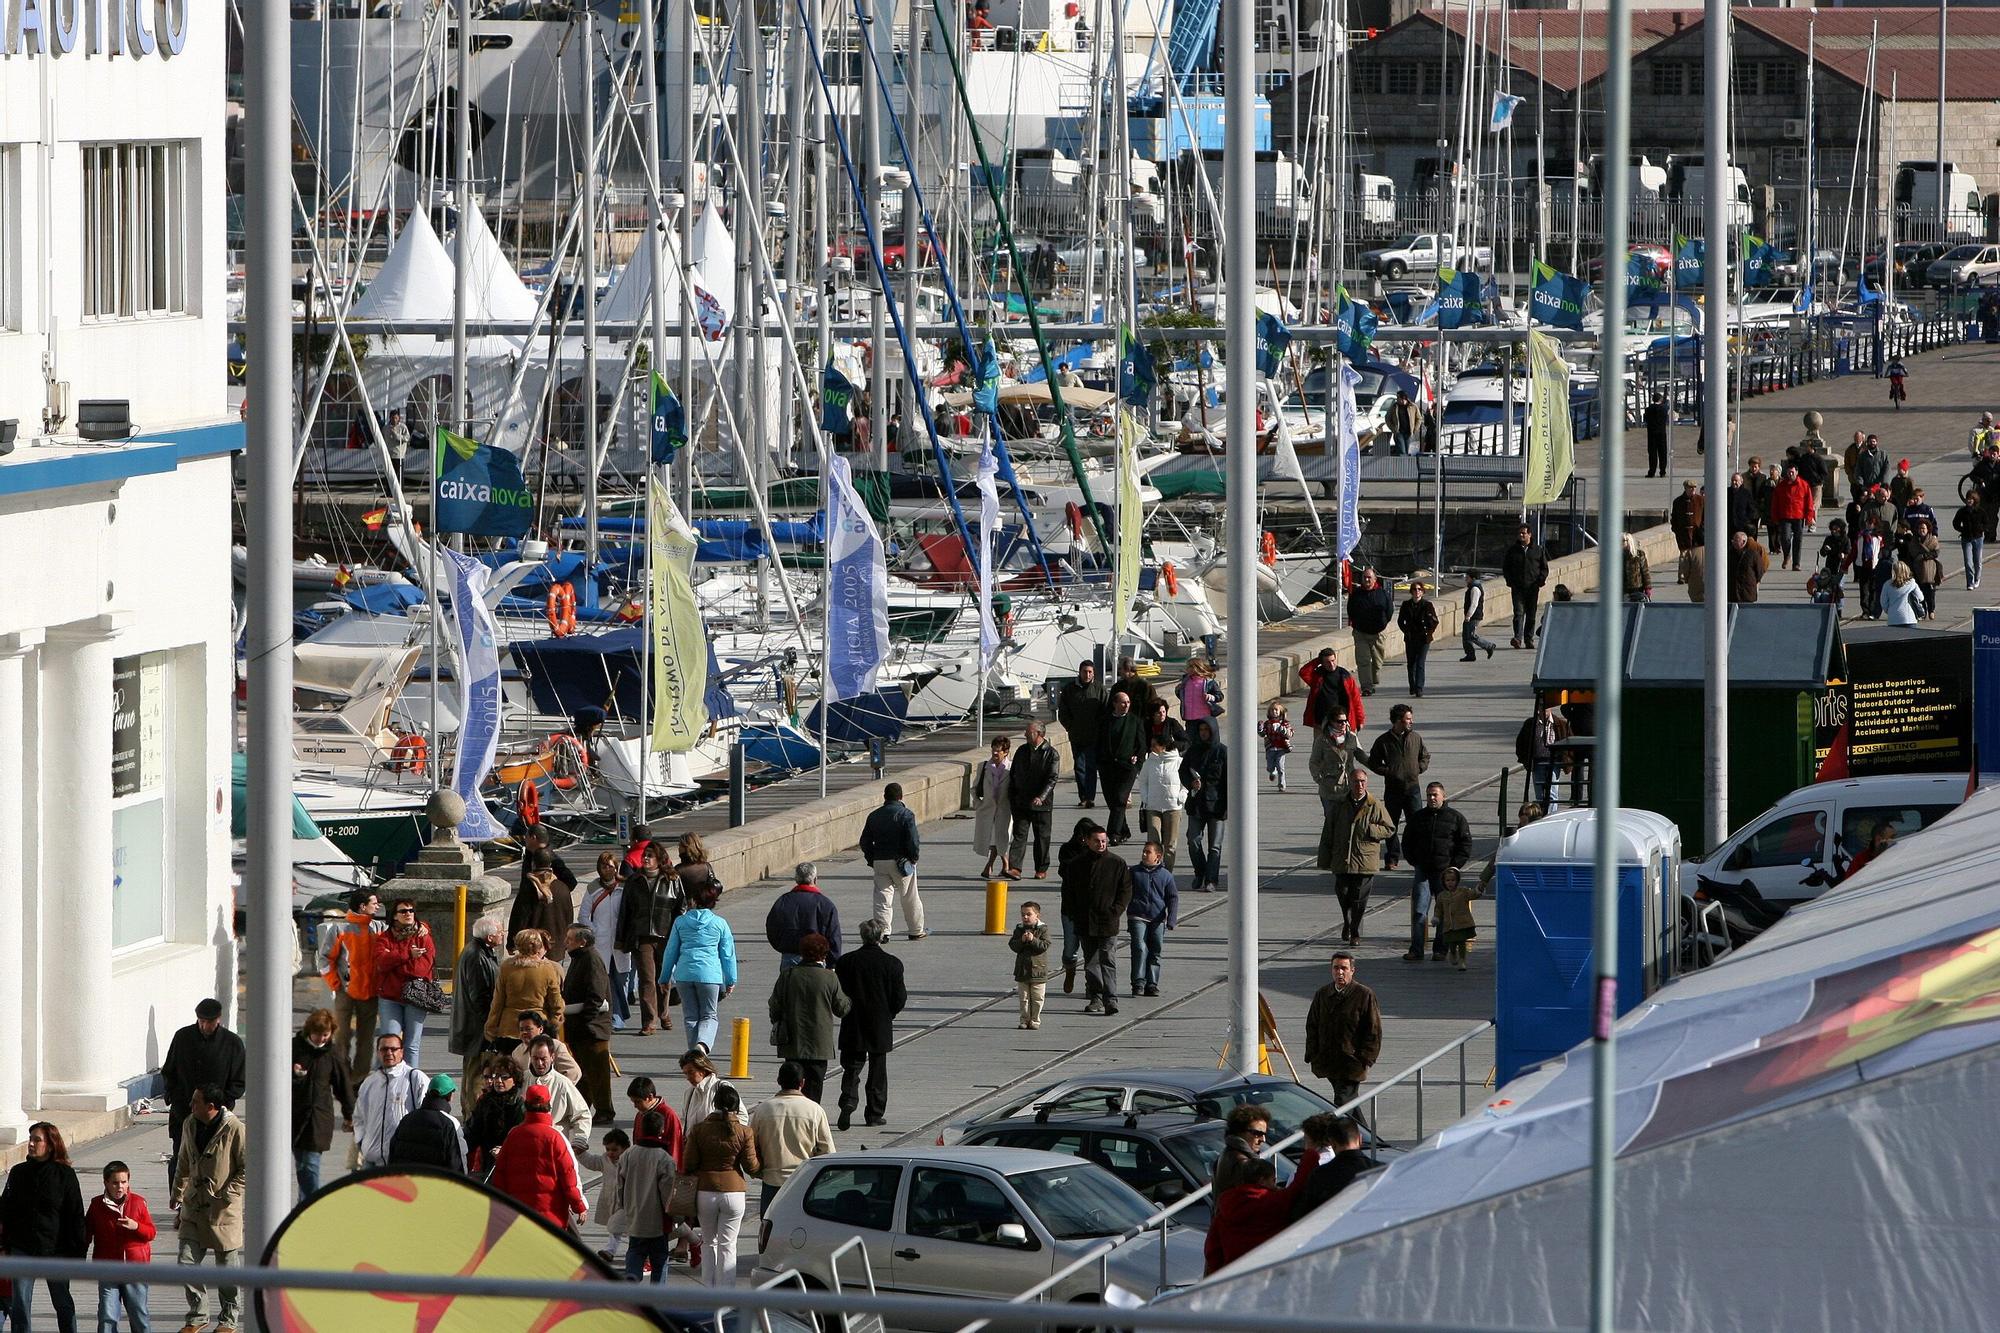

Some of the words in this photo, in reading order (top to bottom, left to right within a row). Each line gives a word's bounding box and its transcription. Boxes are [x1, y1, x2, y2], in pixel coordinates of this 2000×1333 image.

[440, 476, 532, 508] caixanova
[1342, 500, 1352, 549] ALICIA
[842, 564, 859, 608] 2005
[661, 625, 671, 646] DE
[1853, 682, 1883, 691] Eventos
[1885, 678, 1926, 688] Deportivos
[662, 655, 684, 737] TURISMO
[1854, 690, 1904, 700] Dinamizacion
[1916, 686, 1940, 694] Ferias
[1854, 698, 1914, 709] Indoor&Outdoor
[1854, 709, 1880, 718] Cursos
[1881, 708, 1891, 716] de
[1893, 706, 1909, 715] Alto
[1910, 703, 1957, 713] Rendimiento
[1855, 717, 1899, 728] Actividades
[1907, 714, 1934, 723] Medida
[1855, 728, 1889, 737] Acciones
[1891, 726, 1900, 734] de
[1902, 723, 1940, 733] Marketing
